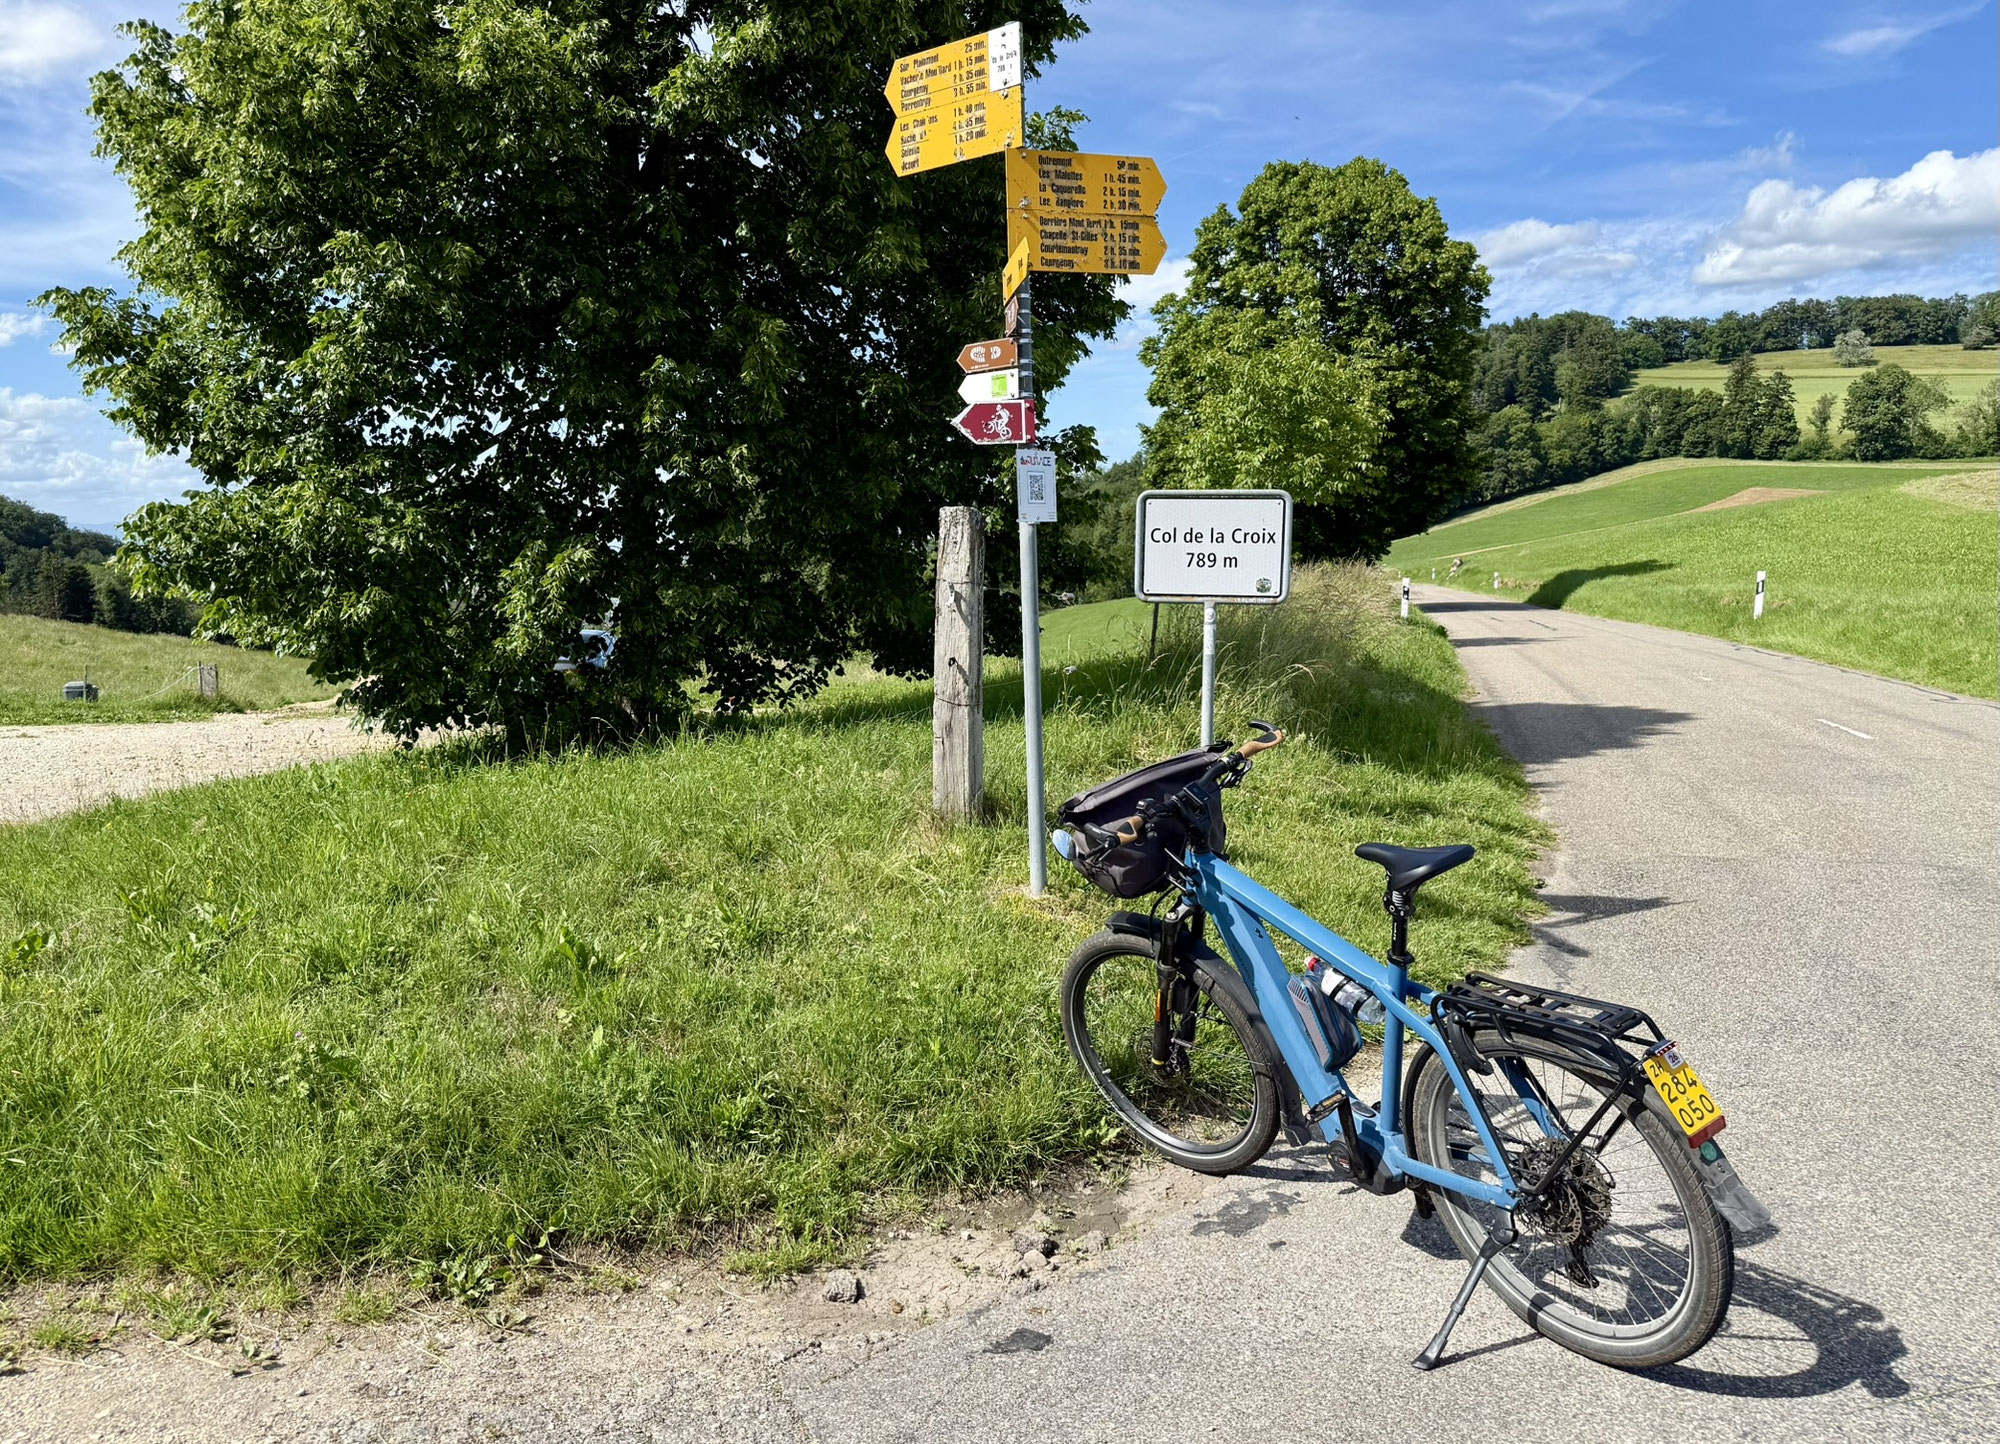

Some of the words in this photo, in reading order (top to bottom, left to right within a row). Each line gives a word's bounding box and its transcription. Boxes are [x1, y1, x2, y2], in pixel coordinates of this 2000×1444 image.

[965, 43, 973, 54] 25
[974, 41, 987, 52] min.
[966, 57, 973, 68] 15
[974, 53, 987, 64] min.
[966, 70, 974, 81] 35
[974, 67, 987, 78] min.
[966, 83, 974, 94] 55
[975, 80, 988, 91] min.
[974, 101, 987, 111] min.
[1038, 154, 1072, 168] Outremont
[1117, 160, 1126, 171] 50
[1127, 161, 1141, 172] min.
[1039, 169, 1050, 179] Les
[1110, 173, 1116, 183] h.
[1117, 173, 1126, 184] 45
[1127, 174, 1141, 185] min.
[1039, 182, 1047, 193] La
[1118, 187, 1126, 198] 15
[1127, 188, 1141, 199] min.
[1039, 196, 1050, 206] Les
[1118, 200, 1126, 211] 30
[1128, 200, 1141, 211] min.
[1039, 230, 1067, 242] Chapelle
[1118, 233, 1126, 244] 15
[1128, 233, 1141, 244] min.
[1110, 246, 1117, 256] h.
[1118, 246, 1127, 256] 35
[1128, 246, 1141, 257] min.
[1040, 256, 1075, 269] Courgenay
[1110, 259, 1117, 270] h.
[1119, 259, 1127, 270] 10
[1150, 527, 1177, 544] Col
[1183, 527, 1204, 544] de
[1210, 527, 1225, 544] la
[1231, 527, 1277, 544] Croix
[1186, 552, 1217, 568] 789
[1223, 556, 1238, 568] m
[1668, 1053, 1679, 1063] 26
[1660, 1068, 1698, 1104] 284
[1678, 1094, 1715, 1128] 050
